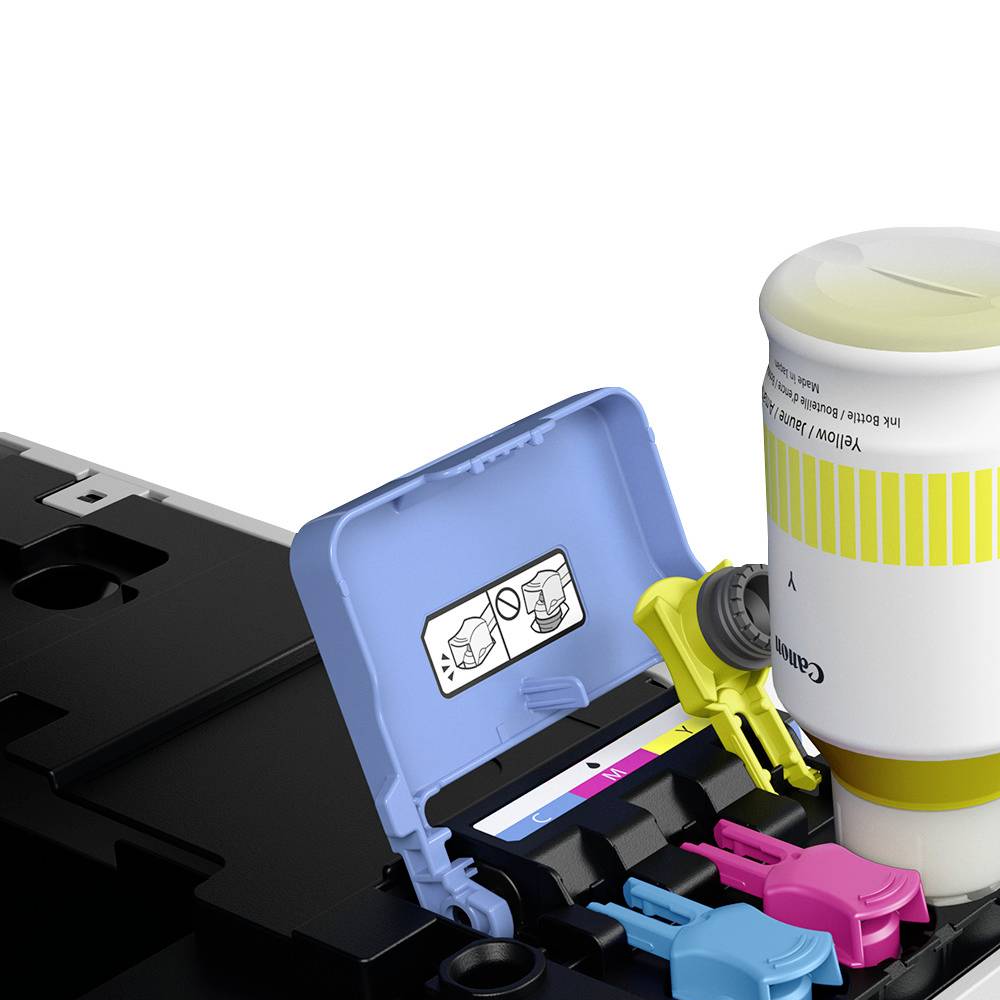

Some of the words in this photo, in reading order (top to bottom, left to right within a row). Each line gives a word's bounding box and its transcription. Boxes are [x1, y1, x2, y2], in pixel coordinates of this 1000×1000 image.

[790, 371, 796, 384] in
[798, 376, 819, 393] Made
[778, 381, 799, 404] d'encre
[800, 395, 838, 419] Bouteille
[779, 409, 807, 436] Jaune
[847, 410, 880, 427] Bottle
[884, 416, 901, 428] Ink
[808, 425, 815, 439] /
[816, 428, 862, 452] Yellow
[788, 570, 797, 591] Y
[775, 635, 825, 684] Canon
[675, 725, 694, 735] Y
[602, 767, 628, 781] M
[531, 812, 552, 824] C
